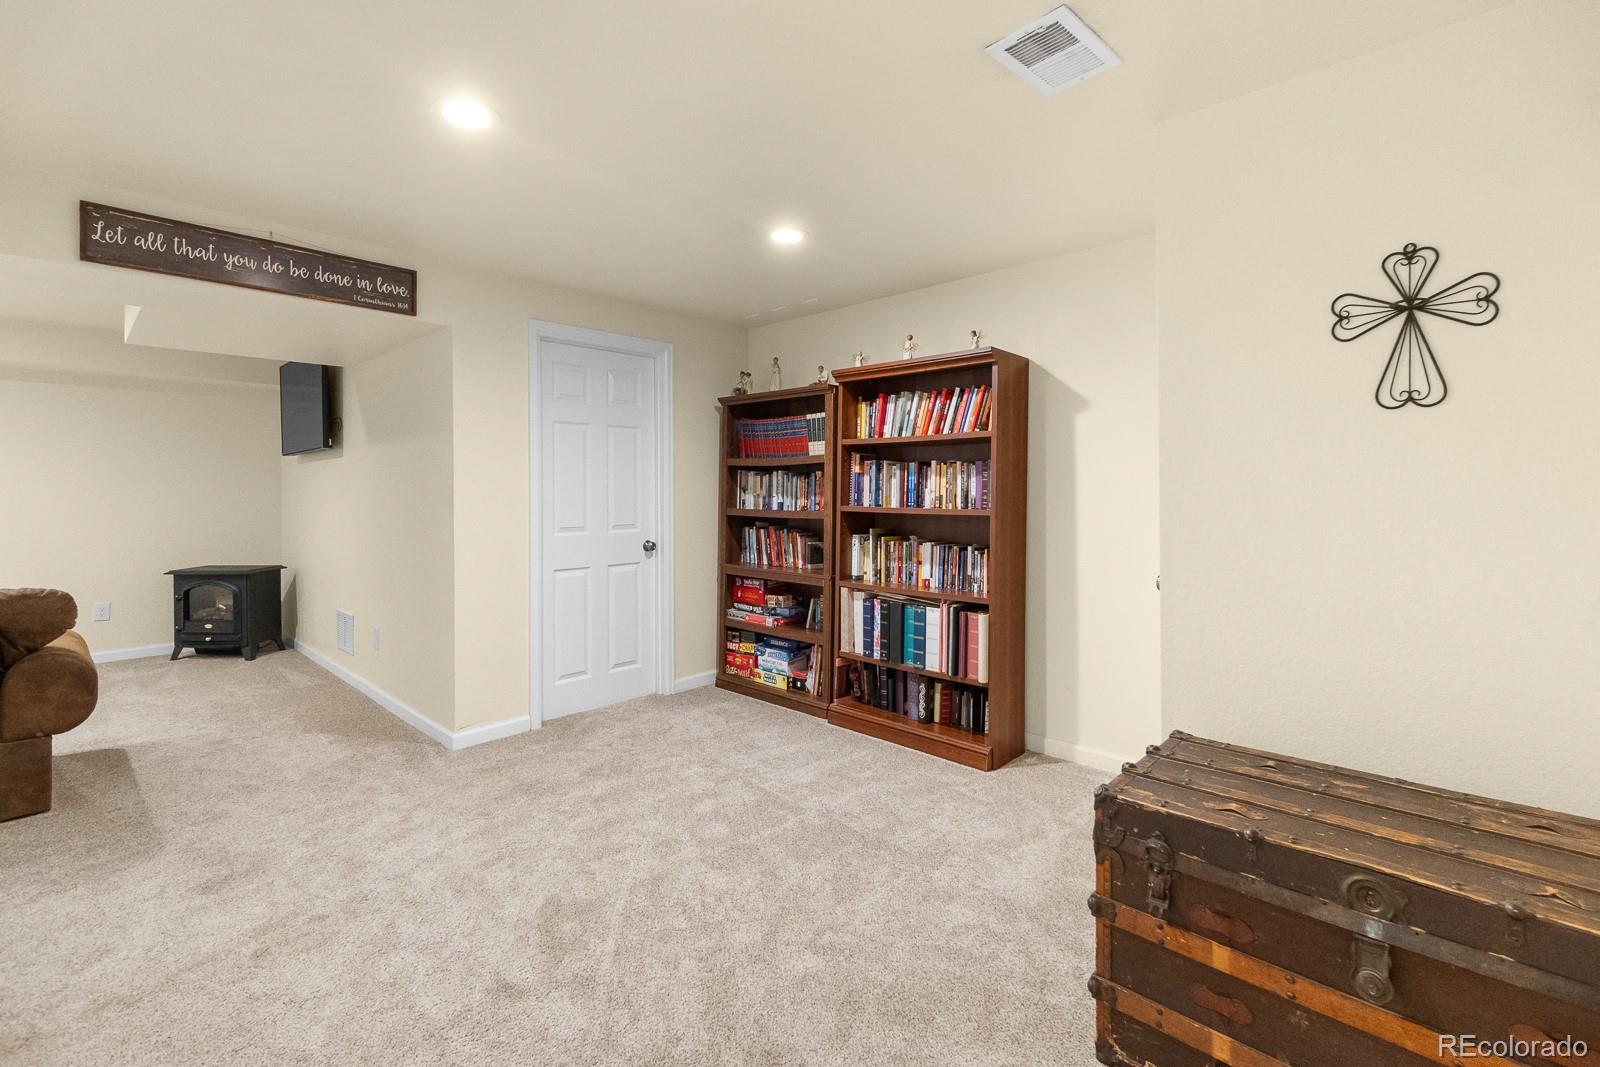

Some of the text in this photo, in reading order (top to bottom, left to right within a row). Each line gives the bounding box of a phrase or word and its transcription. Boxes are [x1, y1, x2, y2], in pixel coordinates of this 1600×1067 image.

[91, 220, 410, 298] Let all that you do be done in love.
[357, 295, 396, 308] Corinthians
